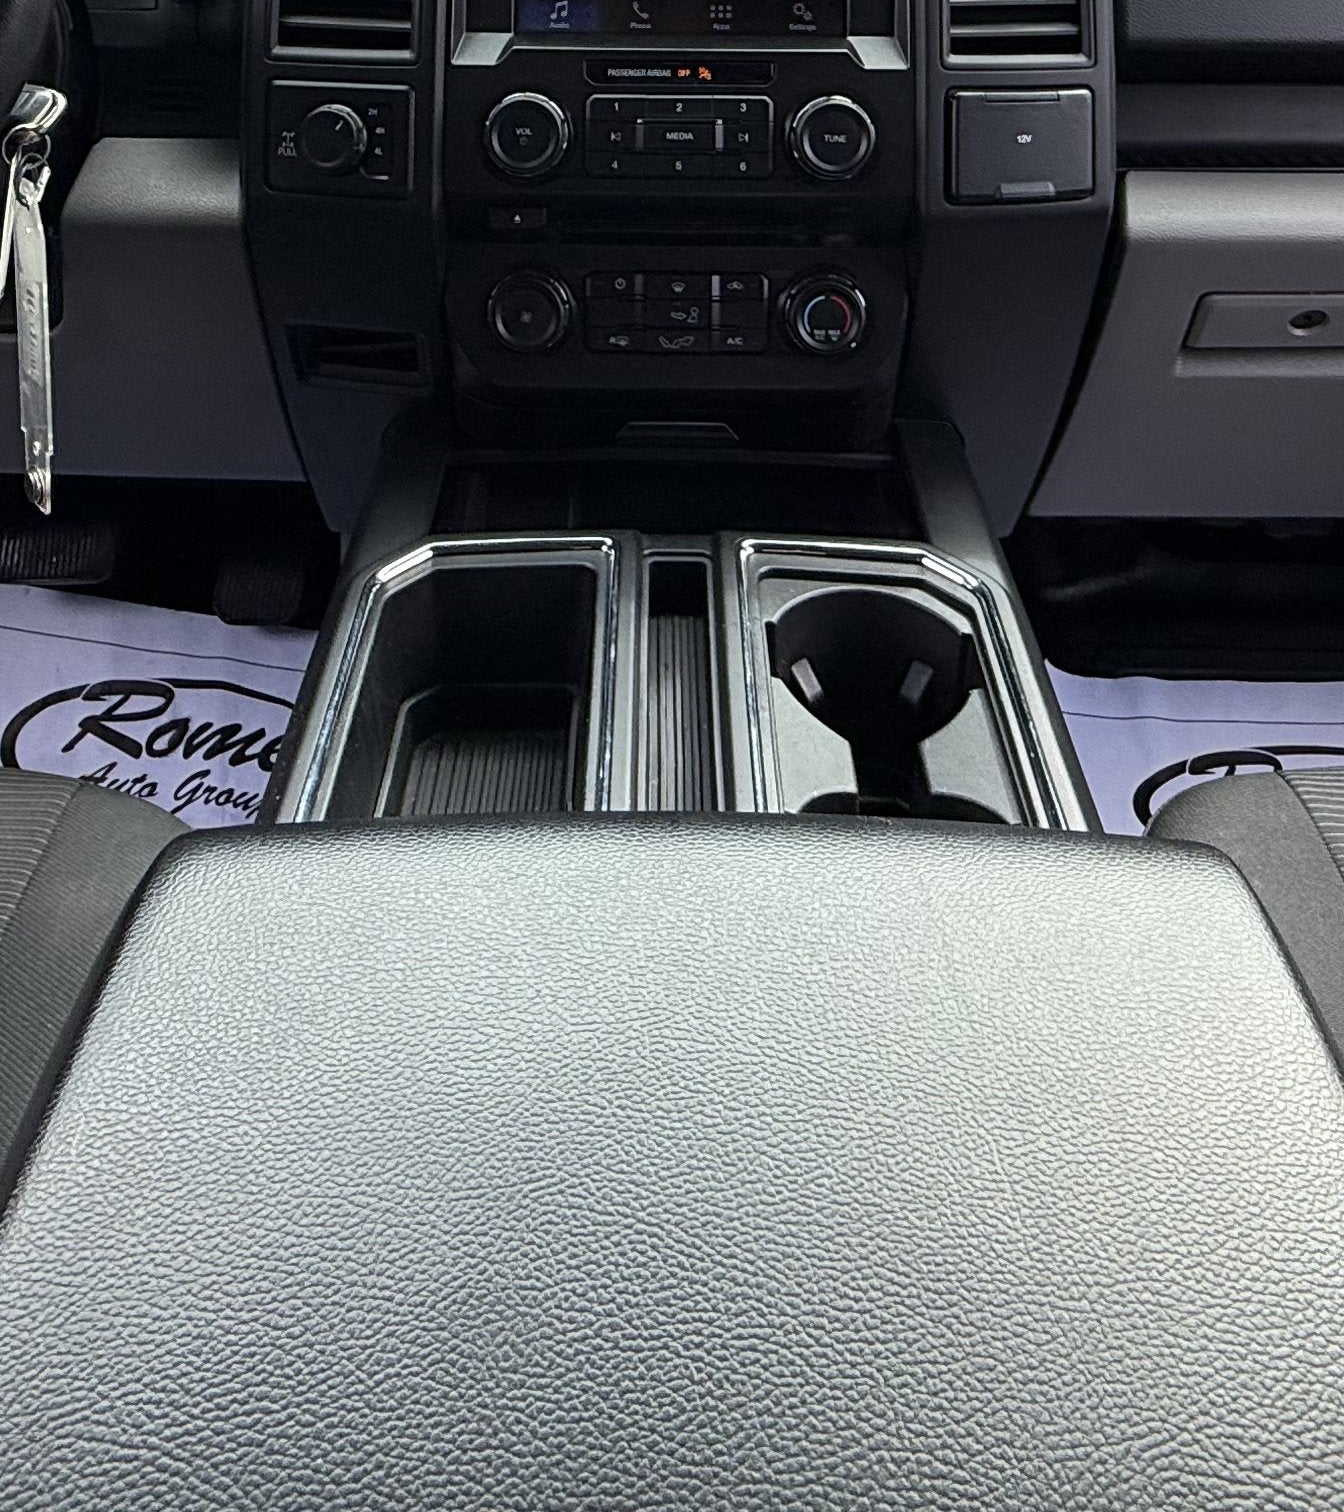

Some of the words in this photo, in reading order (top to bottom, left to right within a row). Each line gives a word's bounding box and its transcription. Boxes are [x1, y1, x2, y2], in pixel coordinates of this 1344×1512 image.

[614, 102, 619, 111] 1
[676, 103, 683, 112] 2
[740, 103, 747, 112] 3
[515, 128, 532, 136] VOL
[666, 132, 694, 140] MEDIA
[823, 135, 847, 143] TUNE
[611, 160, 618, 169] 4
[675, 161, 682, 170] 5
[739, 162, 747, 171] 6
[62, 679, 286, 773] Rome
[79, 761, 159, 800] Auto
